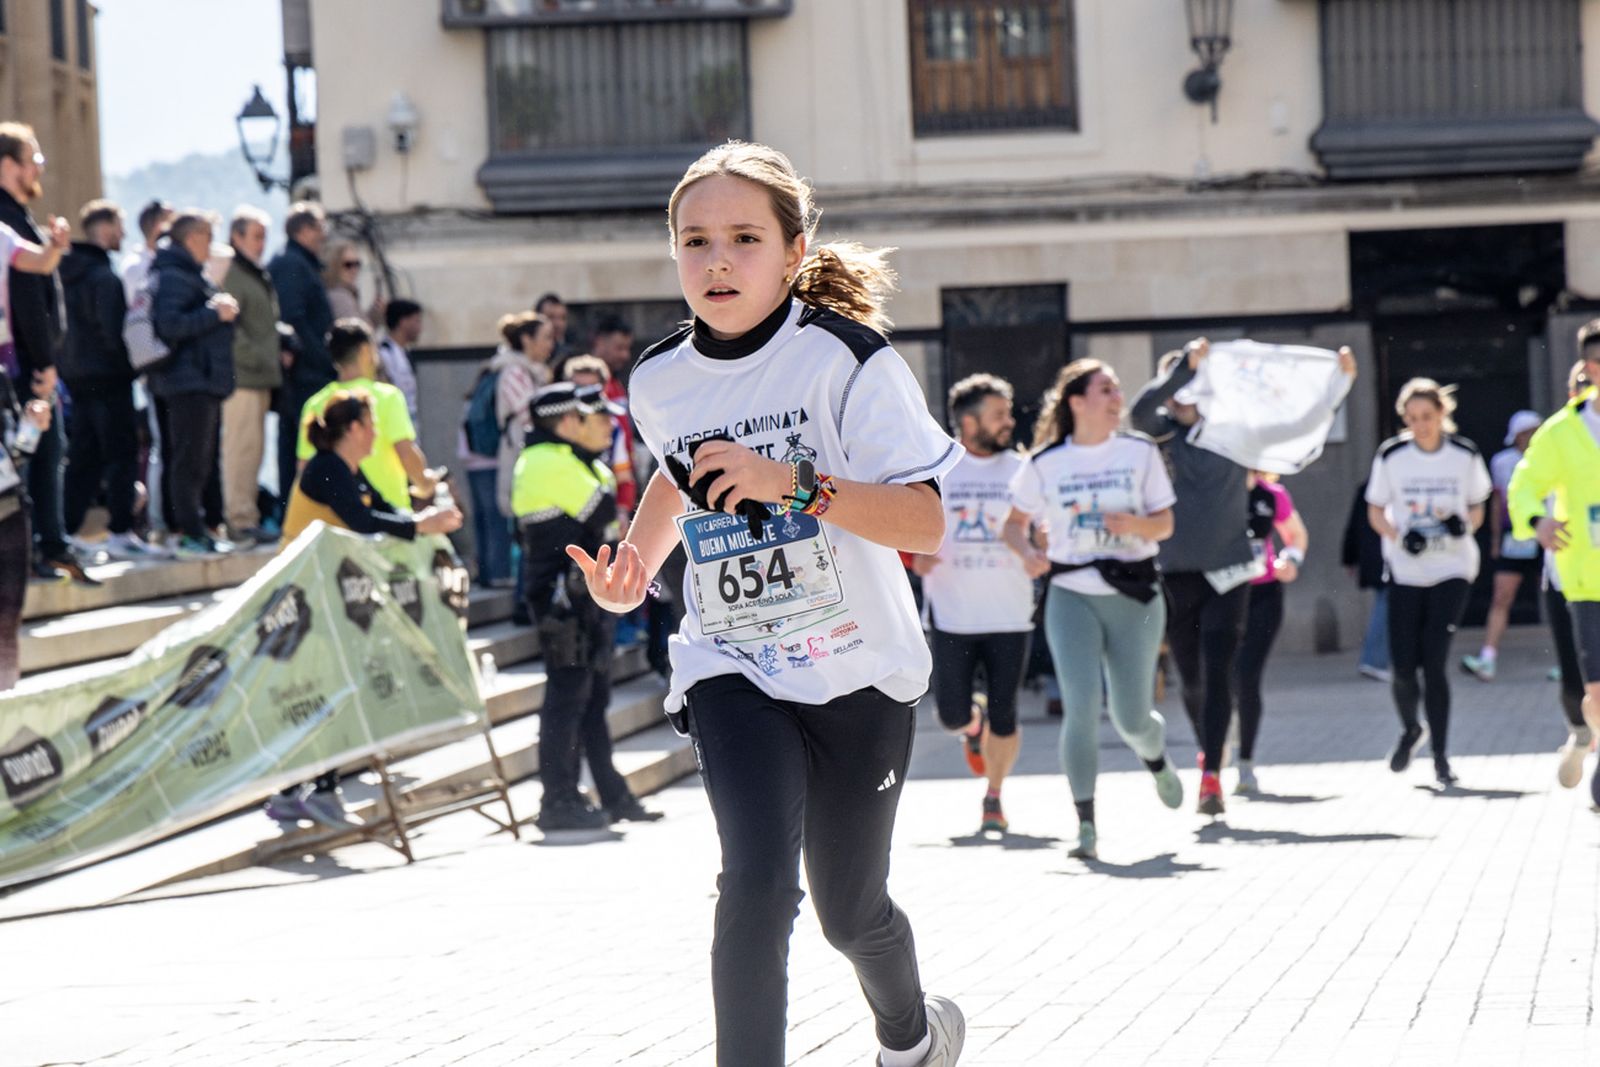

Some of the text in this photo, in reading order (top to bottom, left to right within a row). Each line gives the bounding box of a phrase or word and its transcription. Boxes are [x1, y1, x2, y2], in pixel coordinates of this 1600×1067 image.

[735, 407, 809, 438] CAMINATA
[703, 514, 739, 533] CARRERA
[698, 535, 727, 558] BUENA
[718, 547, 795, 604] 654
[775, 591, 793, 601] SOLA
[830, 624, 858, 639] VICTORIA
